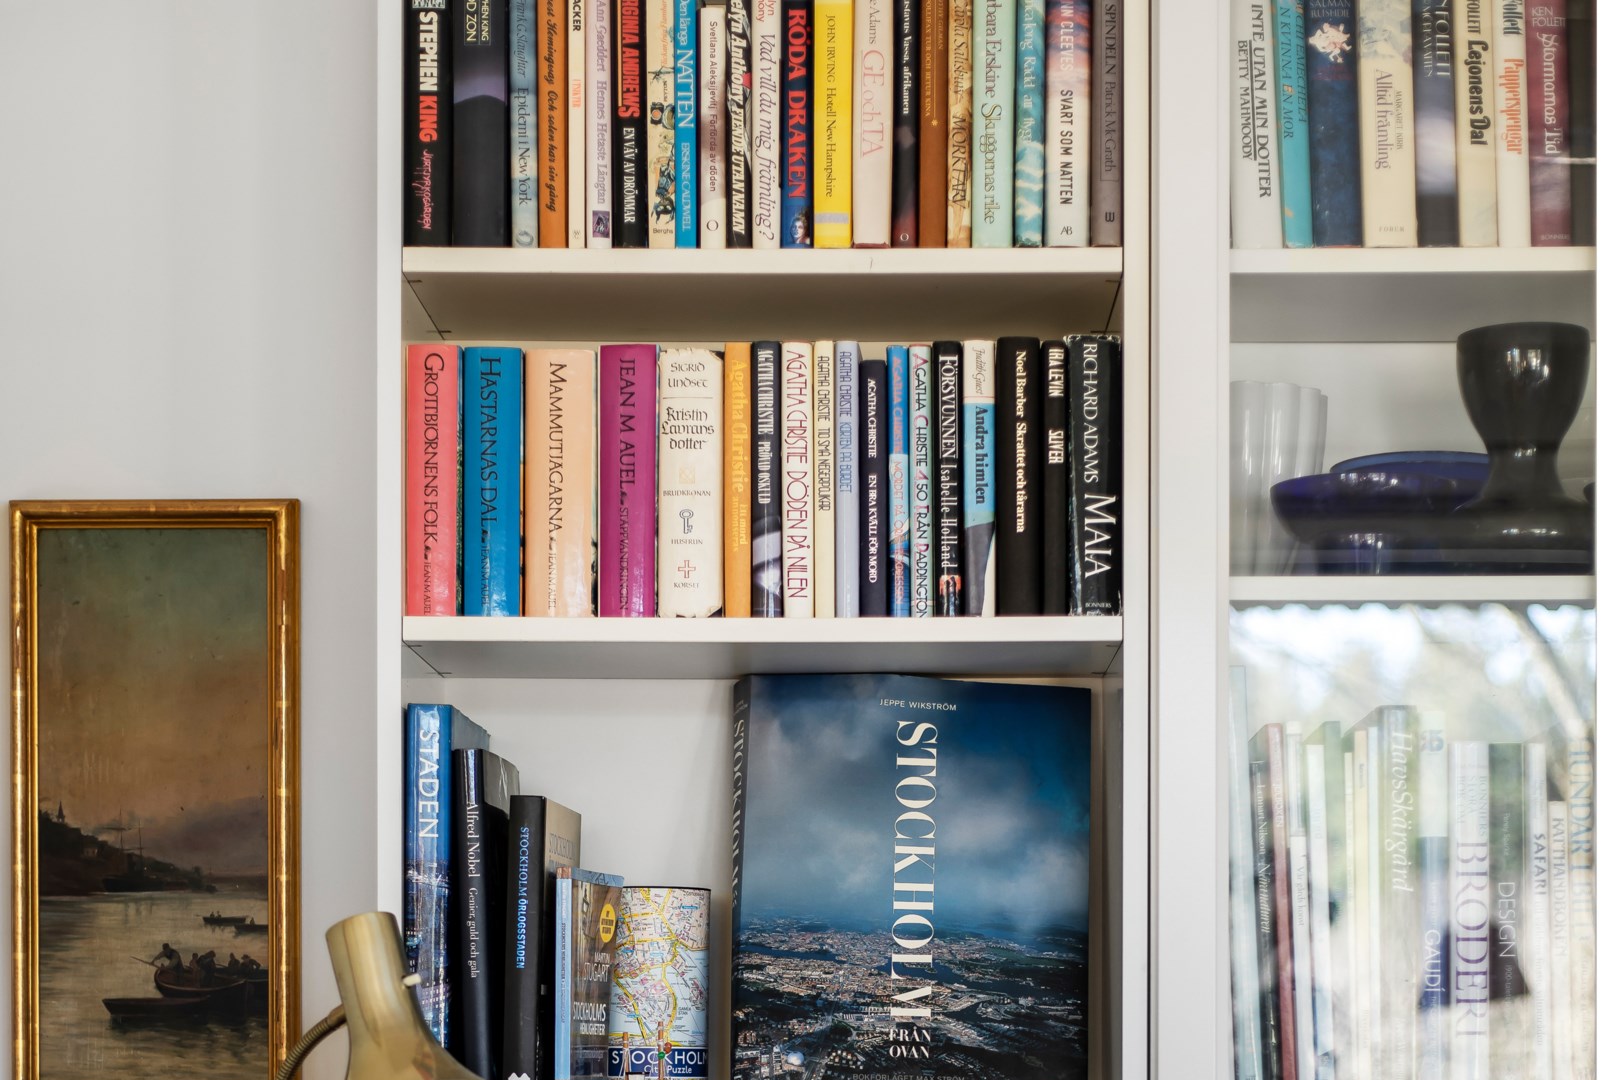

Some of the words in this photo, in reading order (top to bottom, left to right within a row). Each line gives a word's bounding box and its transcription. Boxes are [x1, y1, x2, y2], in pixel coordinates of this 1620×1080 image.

[826, 14, 836, 43] JOHN
[1251, 4, 1265, 42] INTE
[1531, 7, 1553, 17] KEN
[419, 11, 438, 91] STEPHEN
[759, 33, 776, 63] Vad
[788, 8, 811, 81] RÖDA
[826, 47, 836, 82] IRVING
[1238, 40, 1250, 81] BETTY
[677, 49, 694, 128] NATTEN
[728, 34, 747, 106] Anthony
[760, 66, 777, 91] vill
[1253, 47, 1268, 91] UTAN
[1464, 40, 1489, 115] Lejonens
[419, 95, 437, 142] KING
[759, 97, 776, 114] du
[826, 87, 837, 117] Hotell
[1060, 90, 1074, 125] SVART
[1239, 86, 1253, 160] MAHMOODY
[1255, 96, 1269, 129] MIN
[623, 128, 636, 140] EN
[731, 105, 745, 153] FIENDE
[755, 119, 775, 152] mig
[788, 90, 807, 198] DRAKEN
[826, 119, 836, 141] New
[1060, 130, 1074, 156] SOM
[1470, 116, 1491, 145] Dal
[624, 141, 638, 160] VÄV
[624, 161, 635, 174] AV
[824, 143, 836, 198] Hampshire
[1256, 135, 1272, 198] DOTTER
[731, 157, 744, 190] UTAN
[1060, 161, 1073, 205] NATTEN
[623, 176, 638, 223] DRÖMMAR
[732, 190, 745, 235] NAMN
[755, 155, 776, 240] främling?
[1015, 351, 1027, 379] Noel
[1048, 348, 1064, 367] IRA
[620, 357, 636, 408] JEAN
[786, 350, 807, 408] AGATHA
[1015, 380, 1027, 417] Barber
[1048, 368, 1064, 397] LEVIN
[1083, 343, 1099, 420] RICHARD
[620, 415, 636, 432] M
[939, 355, 959, 459] FÖRSVUNNEN
[974, 406, 988, 450] Andra
[785, 410, 808, 464] CHRISTIE
[1015, 422, 1027, 467] Skrattet
[1048, 428, 1064, 464] SLIVER
[1083, 422, 1098, 483] ADAMS
[620, 440, 636, 490] AUEL
[975, 453, 988, 504] himlen
[1016, 469, 1027, 488] och
[480, 487, 497, 529] DAL
[786, 471, 809, 529] DÖDEN
[940, 464, 957, 513] Isabelle
[424, 500, 439, 543] FOLK
[1016, 490, 1028, 532] tårarna
[786, 535, 810, 551] PÅ
[940, 518, 957, 568] Holland
[1083, 493, 1117, 578] MAIA
[787, 557, 808, 599] NILEN
[879, 697, 906, 708] JEPPE
[908, 700, 958, 713] WIKSTRÖM
[419, 729, 439, 838] STADEN
[466, 801, 479, 838] Alfred
[466, 842, 479, 877] Nobel
[518, 826, 530, 897] STOCKHOLM
[890, 720, 939, 1018] STOCKHOLM
[1533, 833, 1547, 896] SAFARI
[467, 887, 479, 919] Genier,
[1499, 881, 1517, 958] DESIGN
[467, 920, 478, 939] guld
[469, 942, 479, 958] och
[516, 898, 529, 968] ÖRLOGSSTADEN
[1455, 841, 1489, 1040] BRODERI
[468, 961, 478, 978] gala
[1424, 930, 1447, 991] GAUDÍ
[573, 1002, 606, 1022] STOCKHOLMS
[889, 1026, 932, 1044] FRÅN
[889, 1044, 930, 1060] OVAN
[667, 1066, 692, 1075] Puzzle
